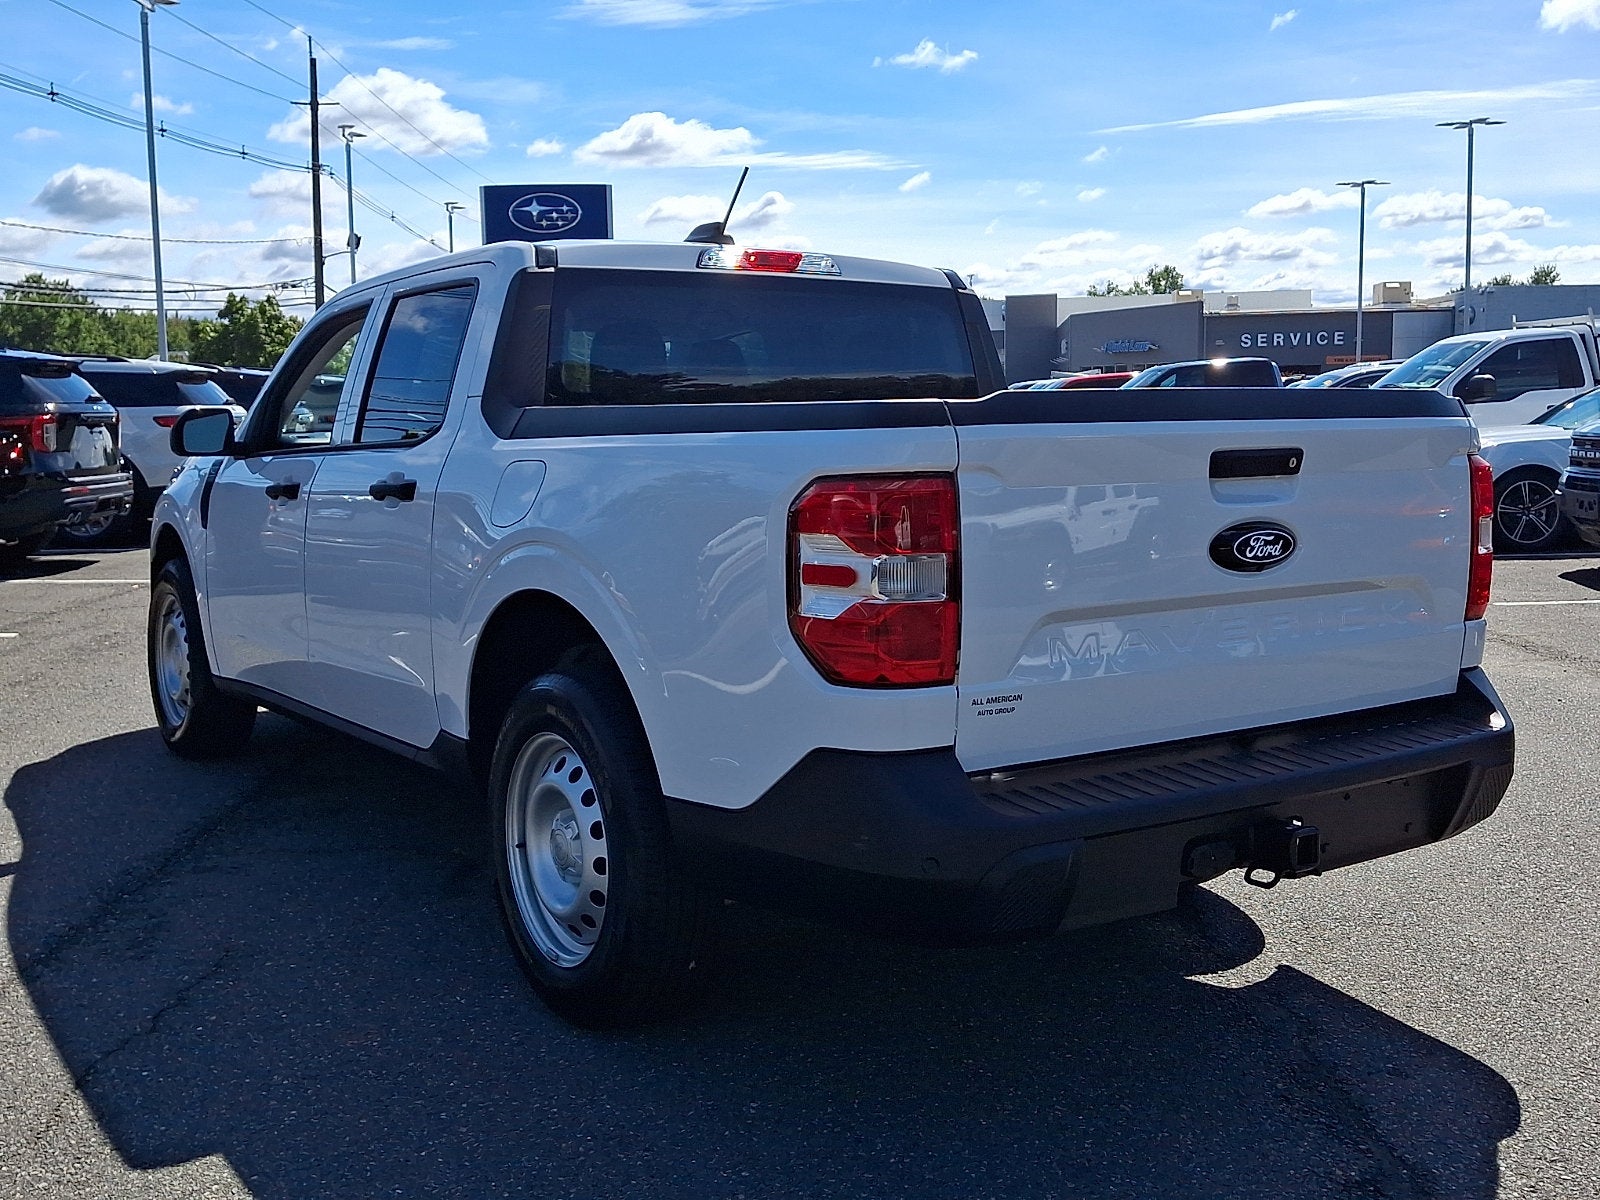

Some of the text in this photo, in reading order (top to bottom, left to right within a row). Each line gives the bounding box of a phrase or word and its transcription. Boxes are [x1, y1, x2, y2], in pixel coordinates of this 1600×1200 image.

[1240, 331, 1345, 348] SERVICE
[1245, 535, 1284, 558] Ford
[1047, 598, 1409, 667] MAVERICK
[971, 694, 1023, 706] ALL AMERICAN
[995, 706, 1016, 715] GROUP
